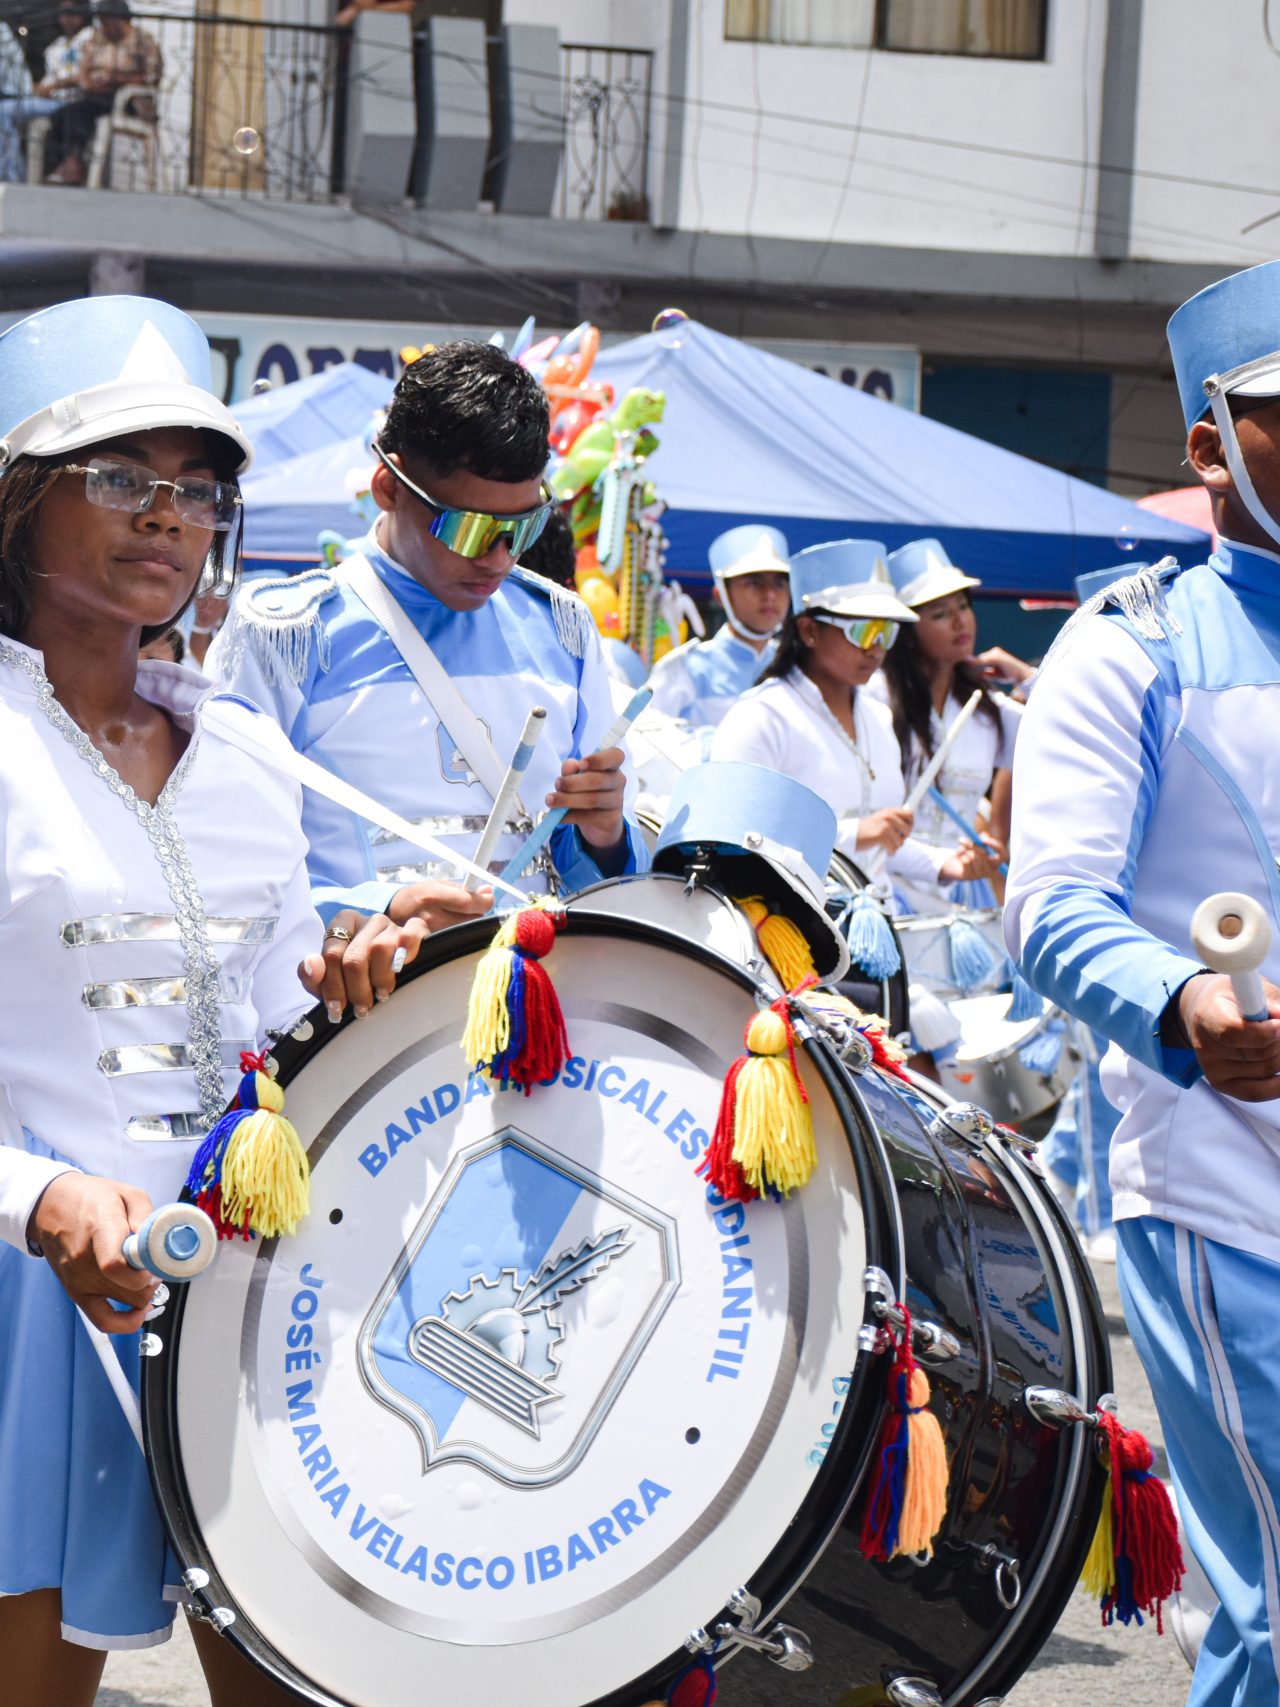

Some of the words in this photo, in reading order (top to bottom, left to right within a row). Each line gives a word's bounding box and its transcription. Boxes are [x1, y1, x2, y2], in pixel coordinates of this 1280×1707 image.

[357, 1070, 492, 1179] BANDA
[498, 1055, 668, 1126] SICAL
[284, 1263, 324, 1375] JOSÉ
[286, 1379, 352, 1519] MARIA
[348, 1503, 516, 1590] VELASCO
[523, 1478, 673, 1585] IBARRA
